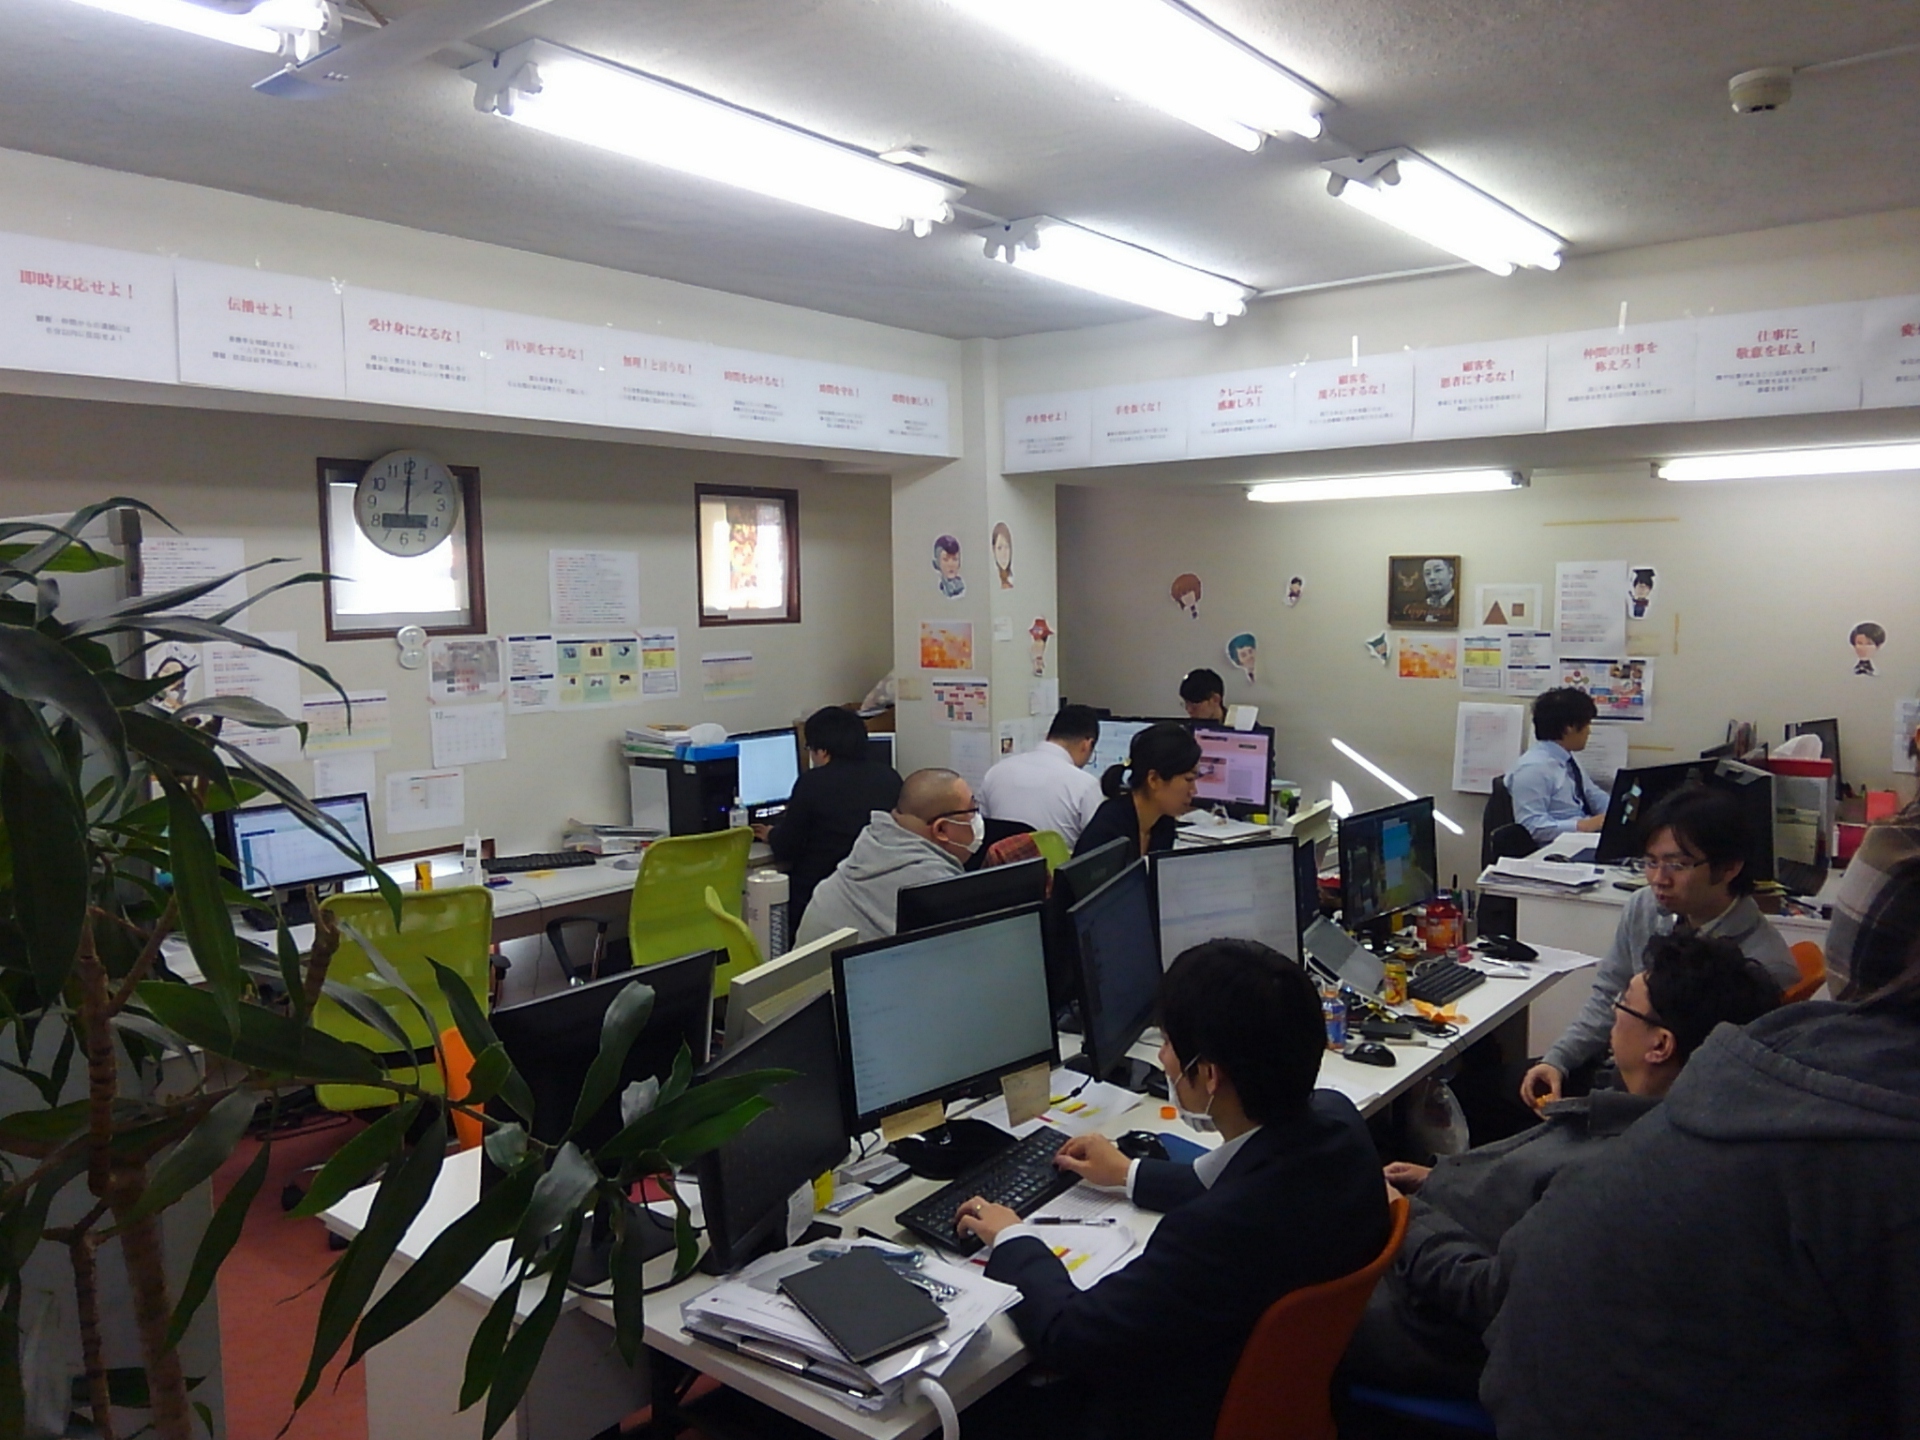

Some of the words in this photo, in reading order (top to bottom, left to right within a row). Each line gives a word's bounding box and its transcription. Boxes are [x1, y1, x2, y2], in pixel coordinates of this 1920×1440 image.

[19, 269, 133, 299] 即時反応せよ！
[368, 318, 460, 344] 受け身になるな！
[1757, 328, 1799, 343] 仕事に
[1583, 342, 1658, 359] 仲間の仕事を
[373, 477, 386, 492] 10
[433, 481, 443, 495] 2
[367, 495, 377, 509] 9
[436, 498, 446, 512] 3
[371, 513, 381, 527] 8
[431, 516, 439, 528] 4
[382, 529, 392, 543] 7
[399, 532, 409, 546] 6
[417, 531, 426, 542] 5
